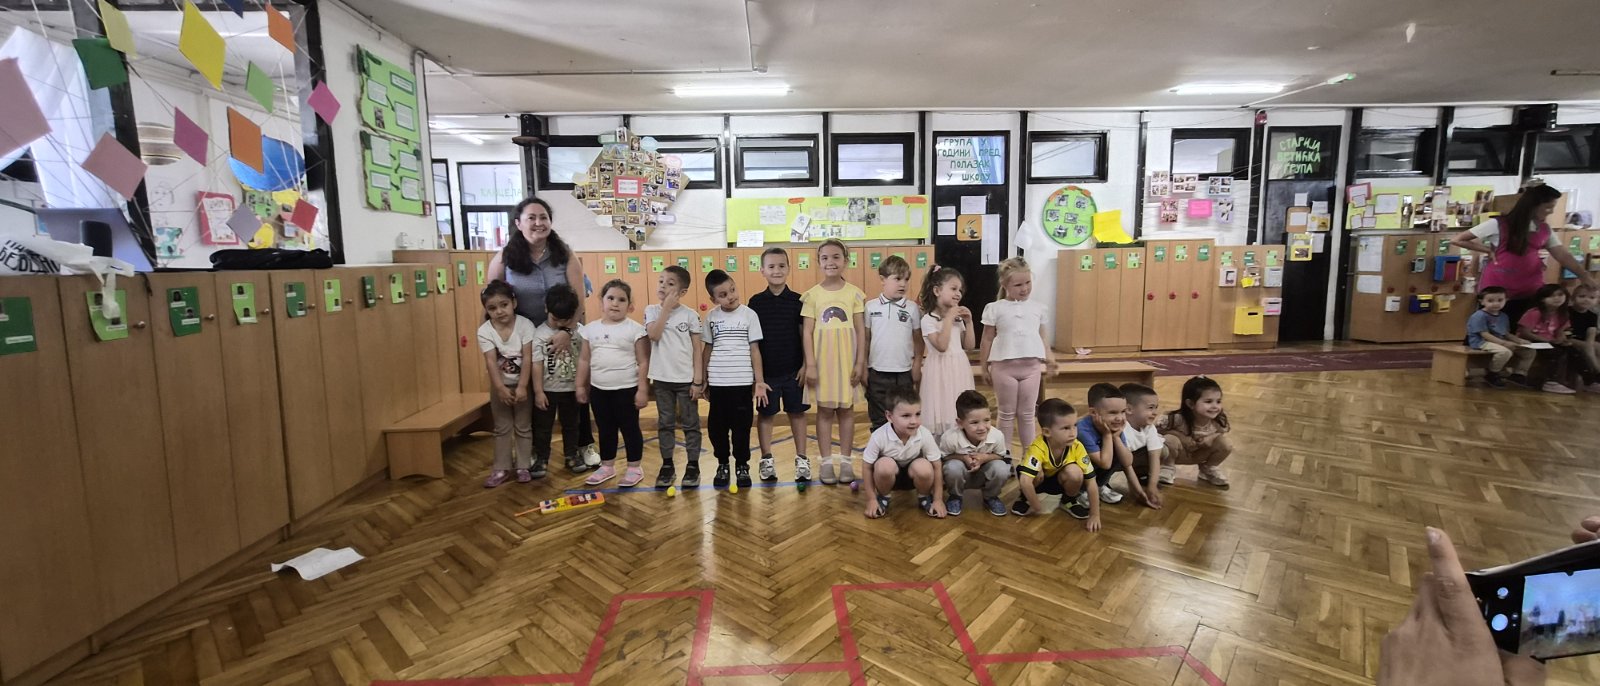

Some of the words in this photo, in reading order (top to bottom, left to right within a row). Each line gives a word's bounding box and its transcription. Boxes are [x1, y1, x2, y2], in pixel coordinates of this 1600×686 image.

[943, 138, 973, 146] ГРУПА
[981, 138, 987, 146] У
[1280, 136, 1321, 151] СТАРИЈА
[937, 148, 971, 157] ГОДИНИ
[979, 148, 1001, 157] ПРЕД
[950, 160, 990, 169] ПОЛАЗАК
[1283, 163, 1313, 174] ГРУПА
[947, 173, 953, 181] У
[961, 173, 991, 181] ШКОЛУ
